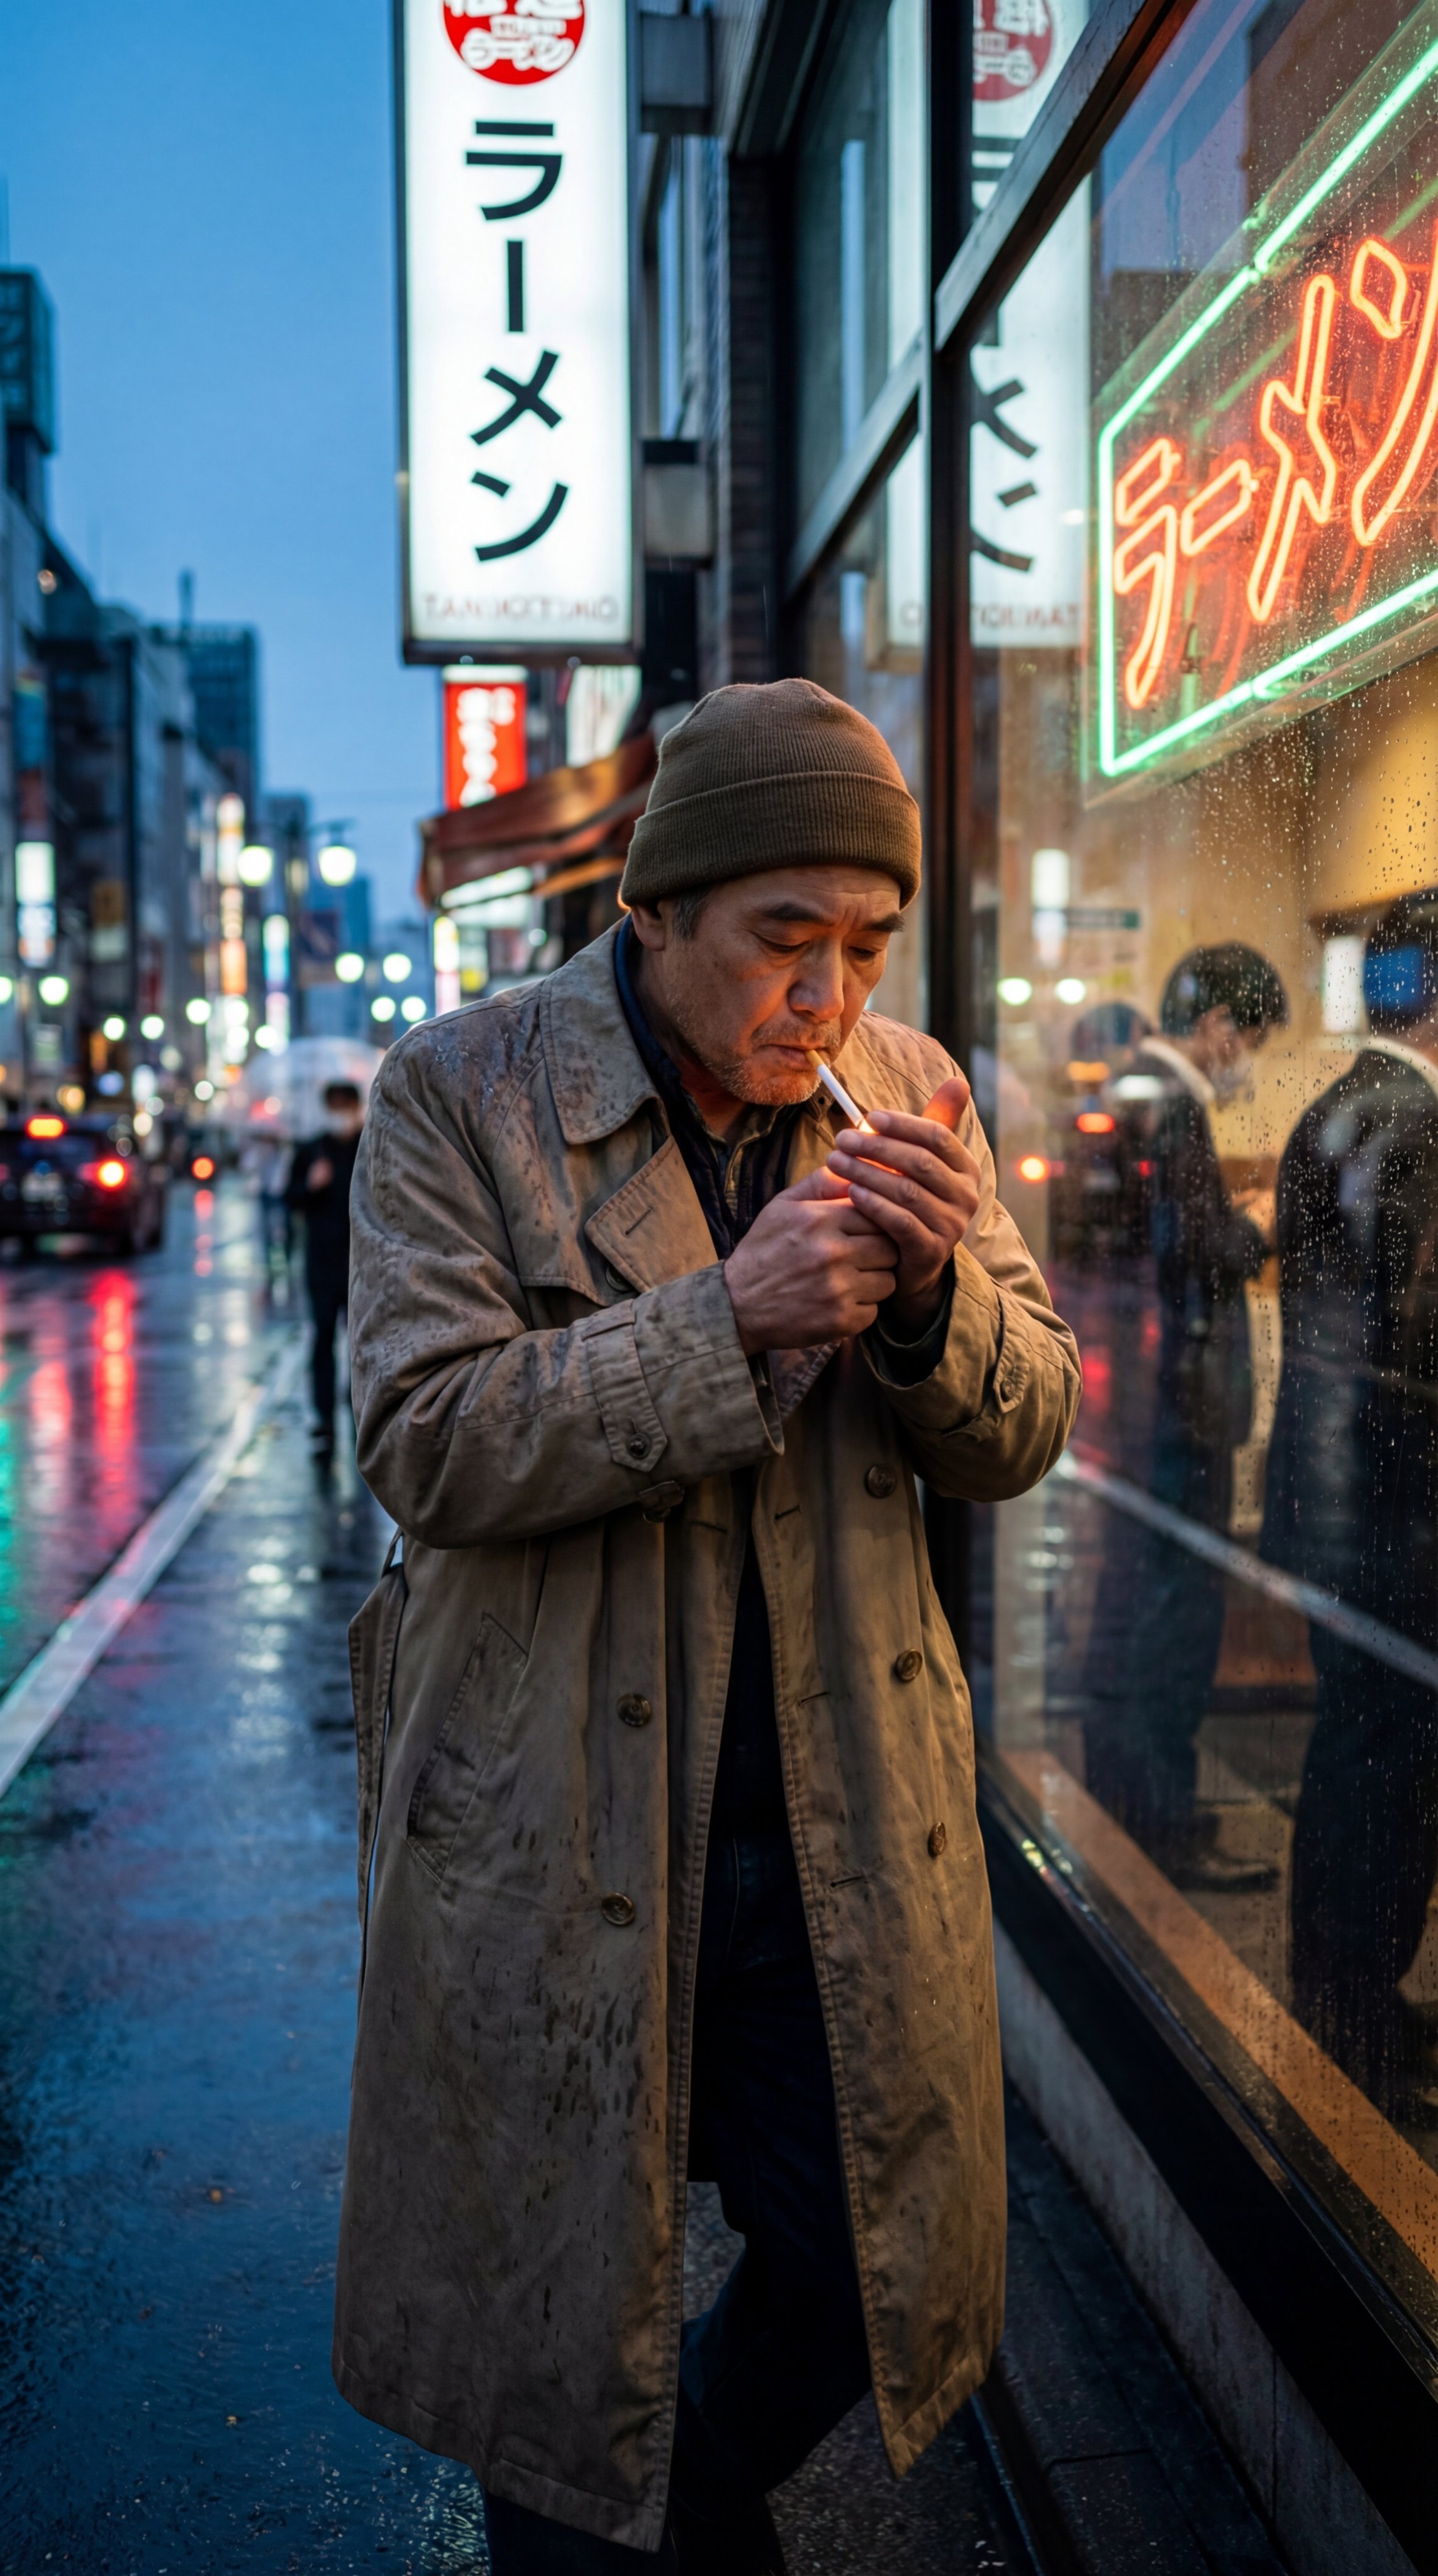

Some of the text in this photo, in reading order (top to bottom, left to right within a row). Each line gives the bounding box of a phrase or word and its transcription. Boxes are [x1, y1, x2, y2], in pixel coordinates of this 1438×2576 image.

[466, 121, 568, 562] ラーメン
[1114, 231, 1438, 711] ラーメン
